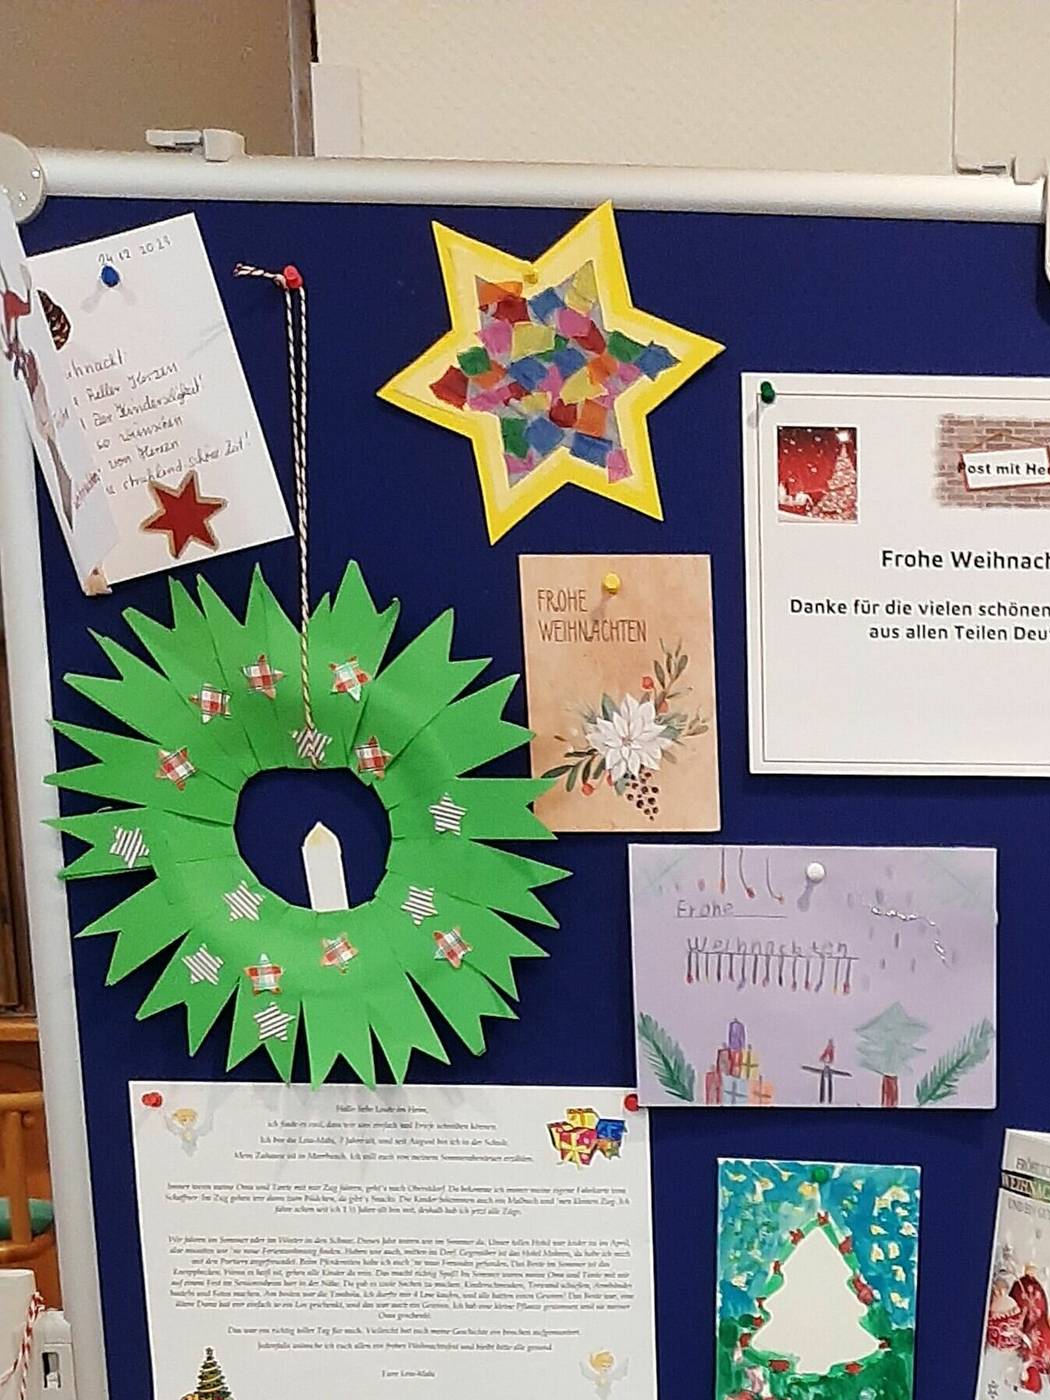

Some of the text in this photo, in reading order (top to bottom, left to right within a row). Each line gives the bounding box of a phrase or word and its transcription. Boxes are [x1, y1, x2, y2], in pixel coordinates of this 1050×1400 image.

[996, 462, 1020, 475] mit
[881, 550, 943, 568] Frohe
[537, 588, 588, 612] FROHE
[790, 599, 847, 614] Danke
[854, 600, 879, 615] für
[885, 600, 912, 615] die
[918, 601, 972, 616] vielen
[978, 602, 1050, 618] schönen
[538, 619, 647, 642] WEIHNACHTEN
[869, 626, 900, 639] aus
[905, 625, 948, 640] allen
[954, 626, 1008, 641] Teilen
[677, 900, 734, 918] Frohe
